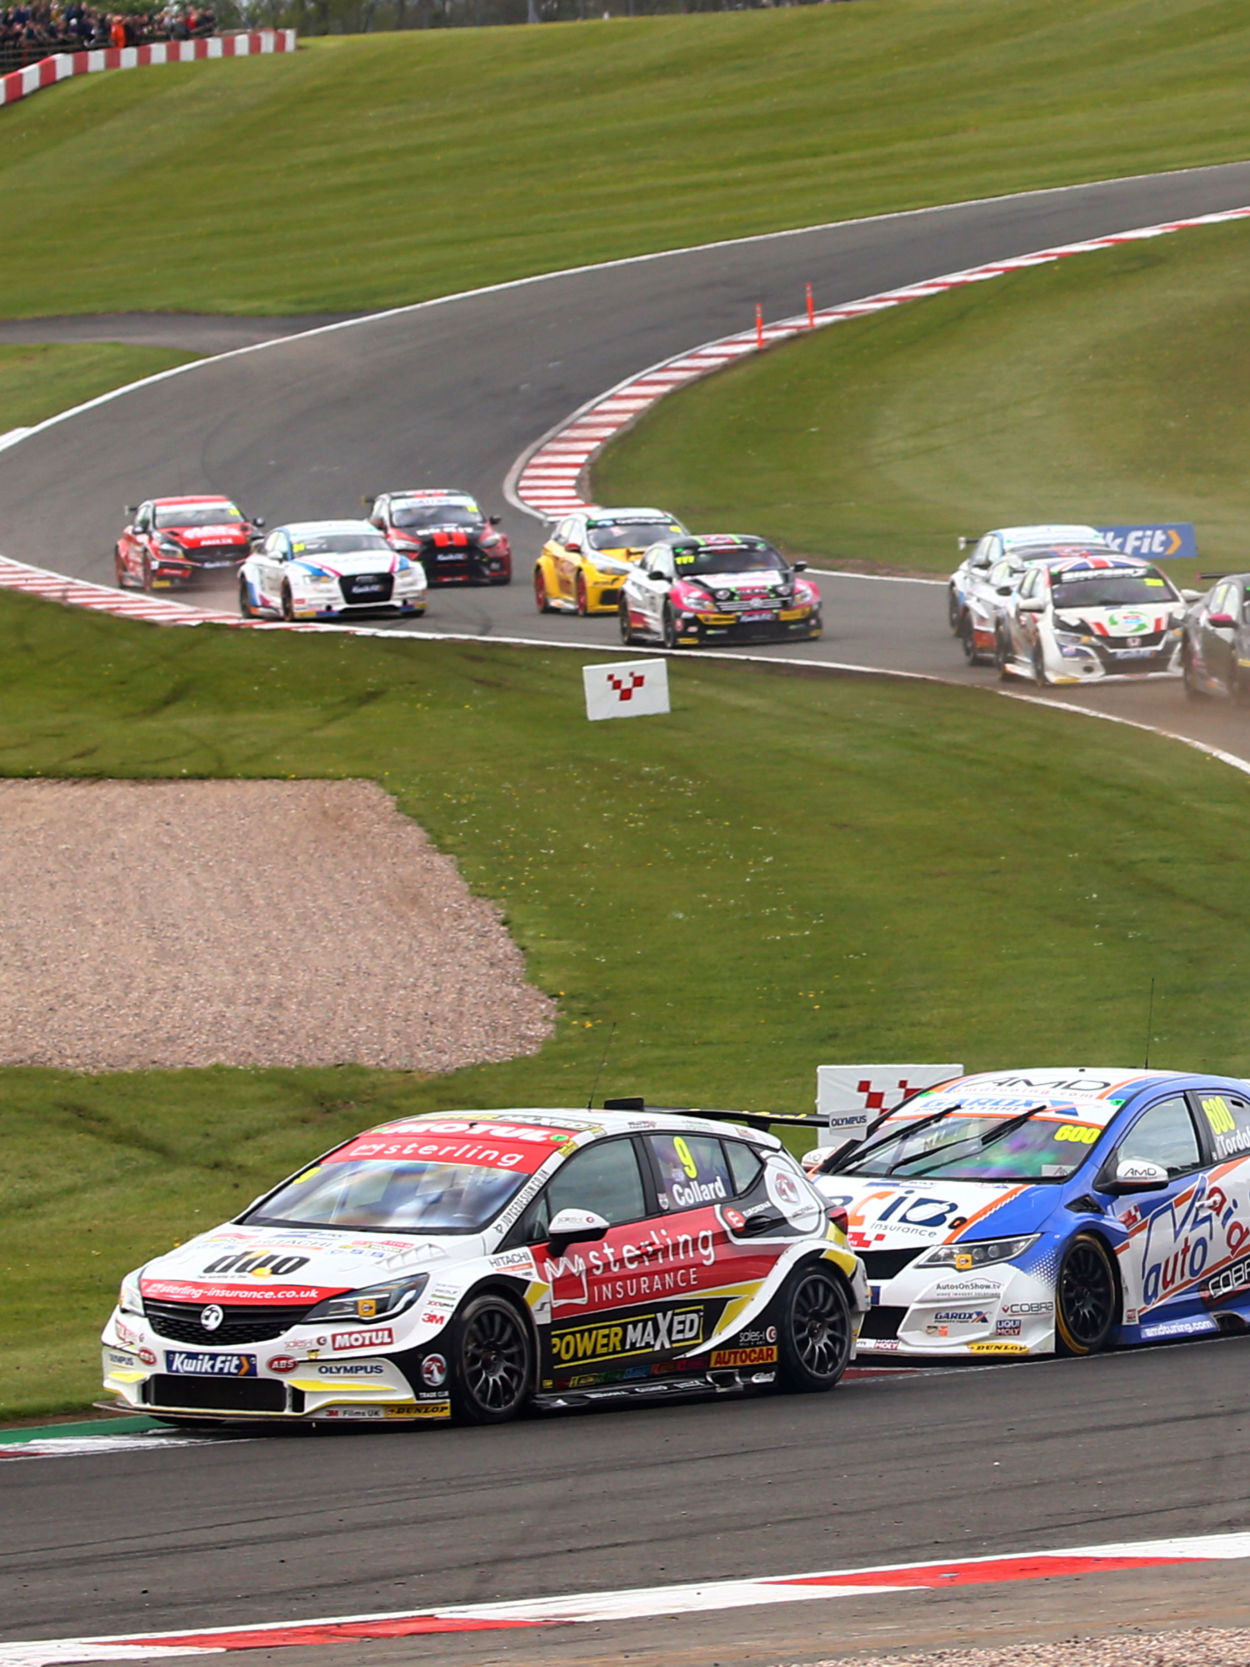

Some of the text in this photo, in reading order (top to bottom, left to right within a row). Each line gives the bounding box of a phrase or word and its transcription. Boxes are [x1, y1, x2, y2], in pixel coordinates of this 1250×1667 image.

[964, 1077, 1112, 1092] AMD
[831, 1115, 867, 1127] OLYMPUS
[1201, 1096, 1236, 1135] 600
[386, 1121, 551, 1142] MOTUL
[1054, 1124, 1101, 1145] 600
[384, 1143, 525, 1168] sterling
[673, 1135, 698, 1180] 9
[1124, 1167, 1157, 1177] AMD
[672, 1176, 727, 1206] Collard
[870, 1222, 938, 1239] insurance
[488, 1251, 532, 1268] HITACHI
[588, 1228, 716, 1276] sterling
[160, 1282, 320, 1300] sterling-insurance.co.uk
[593, 1267, 699, 1303] INSURANCE
[936, 1282, 1001, 1291] AutosOnShow.tv
[421, 1312, 445, 1325] 3M
[997, 1320, 1020, 1328] LIQUI
[334, 1330, 392, 1349] MOTUL
[552, 1310, 700, 1361] POWER MAXED
[997, 1328, 1020, 1336] MOLY
[975, 1343, 1029, 1352] DUNLOP
[271, 1360, 295, 1370] ABS
[713, 1347, 777, 1366] AUTOCAR
[318, 1365, 384, 1375] OLYMPUS
[342, 1409, 367, 1418] Films
[394, 1405, 449, 1415] DUNLOP
